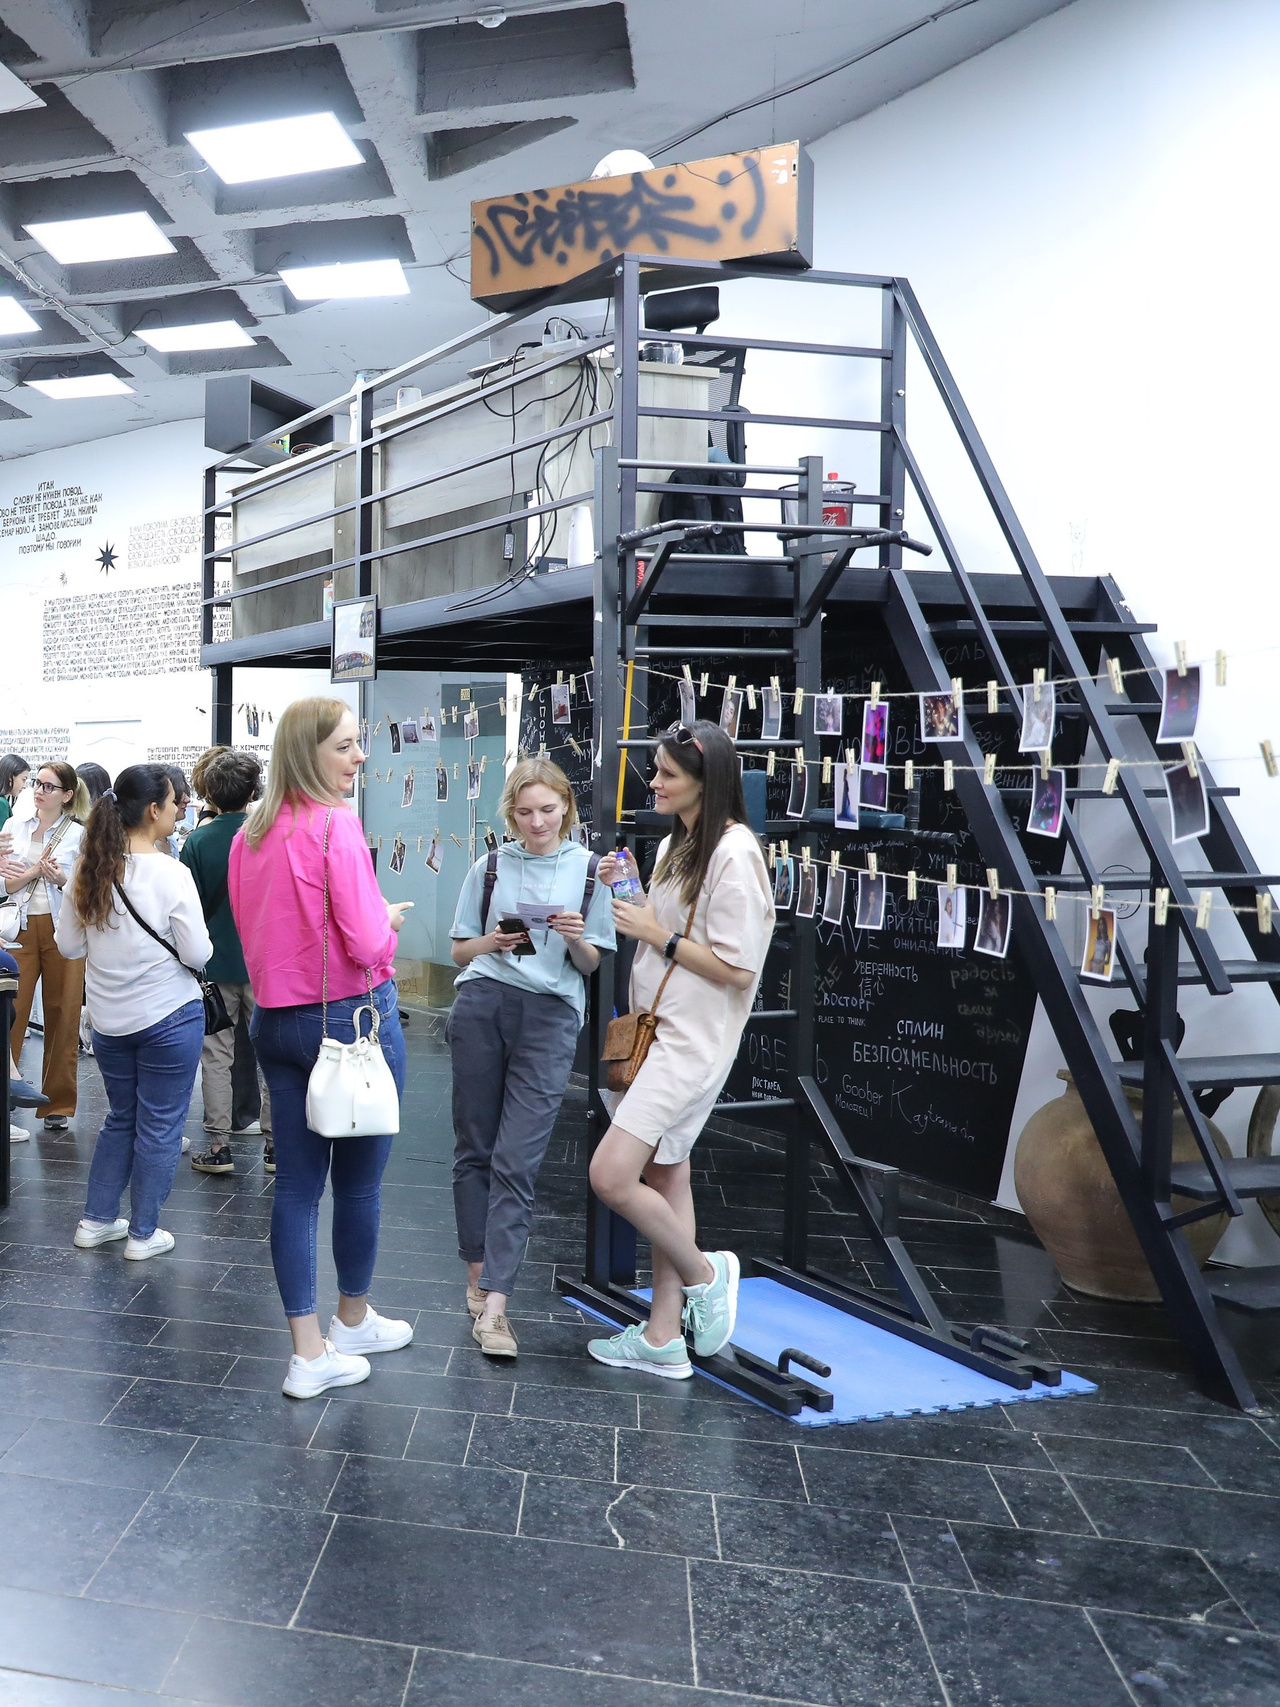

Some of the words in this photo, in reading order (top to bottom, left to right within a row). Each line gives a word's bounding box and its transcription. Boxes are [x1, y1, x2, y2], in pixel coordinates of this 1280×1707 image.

[37, 480, 55, 492] ИТАК
[13, 493, 34, 506] СЛОВУ
[35, 492, 42, 502] НЕ
[10, 506, 17, 516] НЕ
[853, 959, 919, 983] УВЕРЕННОСТЬ
[858, 975, 885, 999] 信心
[822, 992, 875, 1012] ВОСТОРГ
[896, 1019, 944, 1040] СПЛИН
[852, 1041, 998, 1085] БЕЗПОХМЕЛЬНОСТЬ
[842, 1074, 884, 1106] Goober
